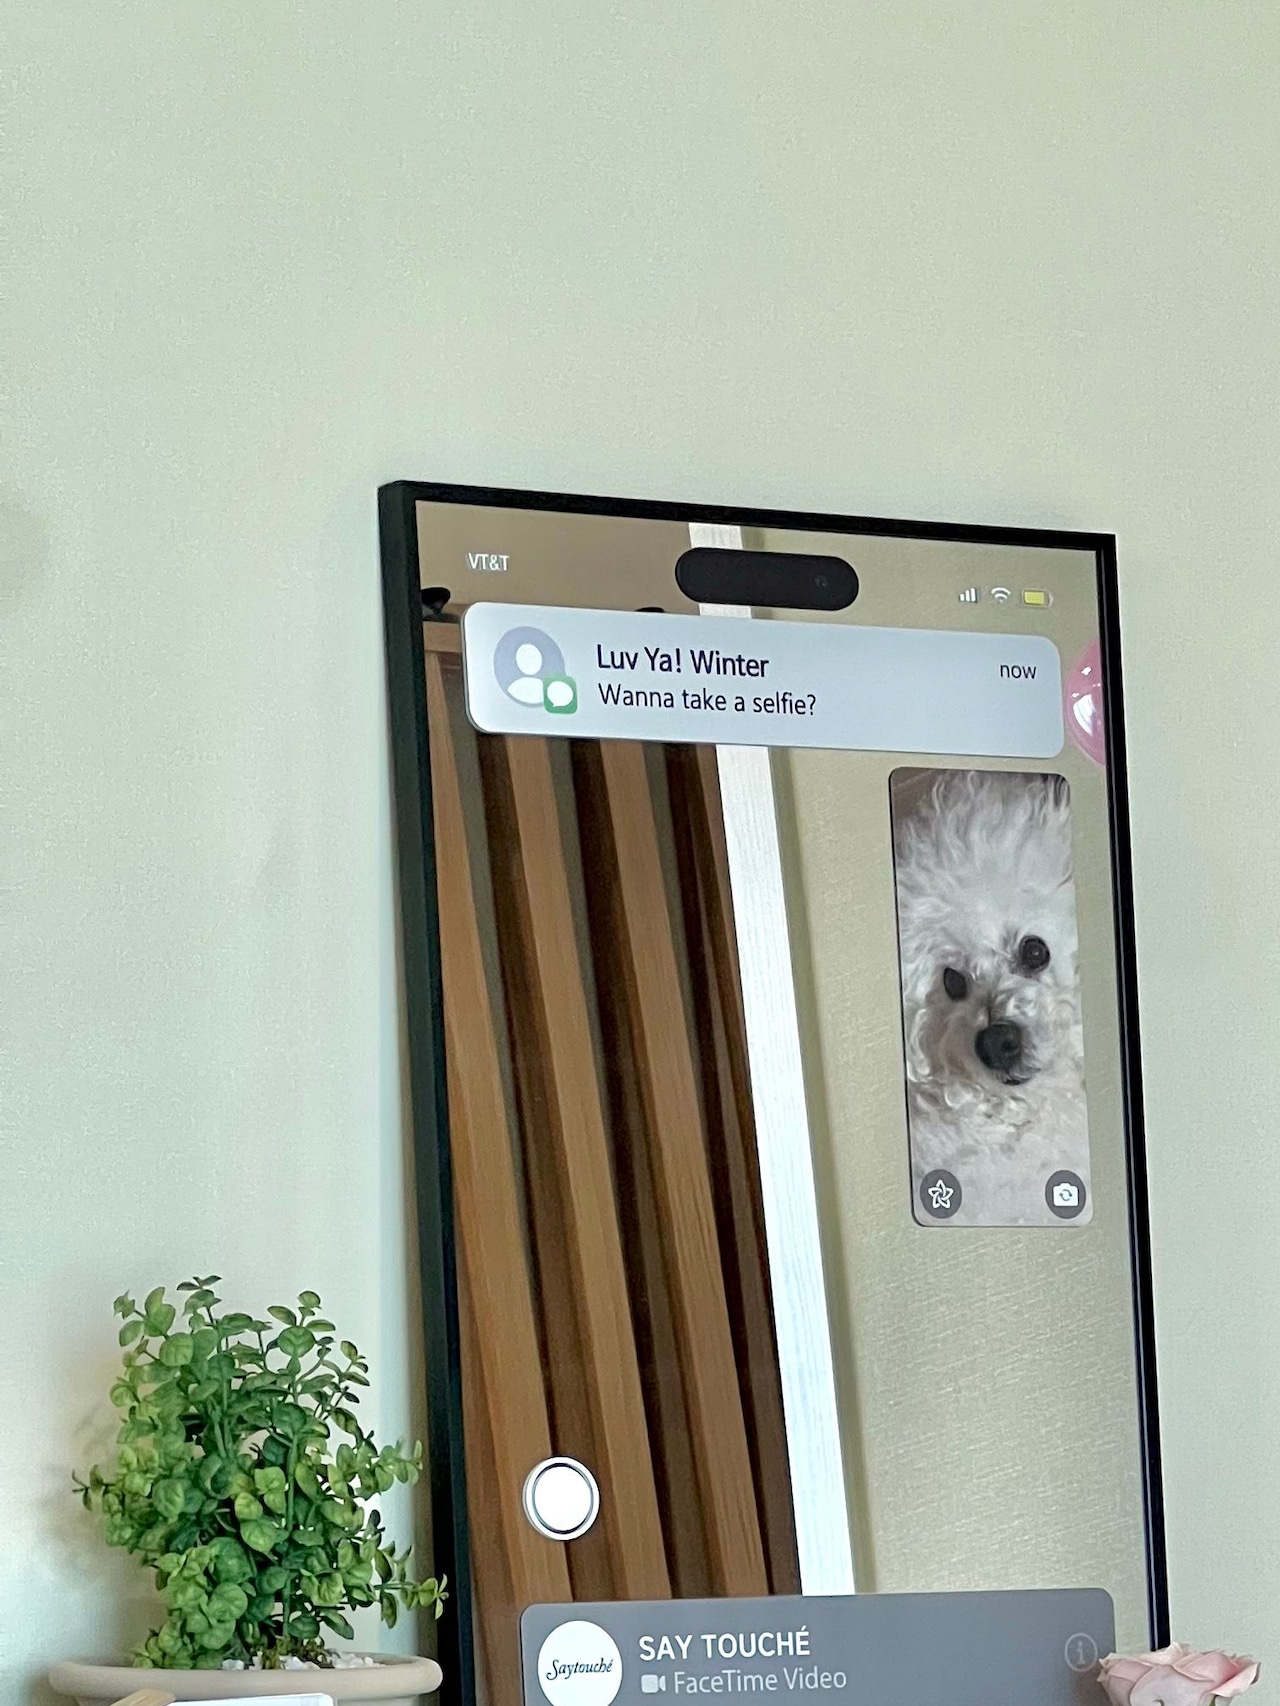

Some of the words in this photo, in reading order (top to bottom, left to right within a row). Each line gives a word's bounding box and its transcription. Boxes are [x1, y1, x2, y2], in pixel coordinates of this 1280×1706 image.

[468, 552, 511, 571] VT&T
[596, 643, 639, 670] Luv
[644, 646, 682, 673] Ya!
[690, 649, 770, 678] Winter
[1000, 664, 1037, 680] now
[598, 682, 675, 708] Wanna
[682, 687, 727, 711] take
[734, 694, 745, 712] a
[753, 691, 817, 716] selfie?
[638, 1634, 693, 1662] SAY
[701, 1625, 811, 1659] TOUCHÉ
[546, 1657, 614, 1681] Saytouché
[673, 1668, 778, 1694] FaceTime
[783, 1665, 848, 1690] Video
